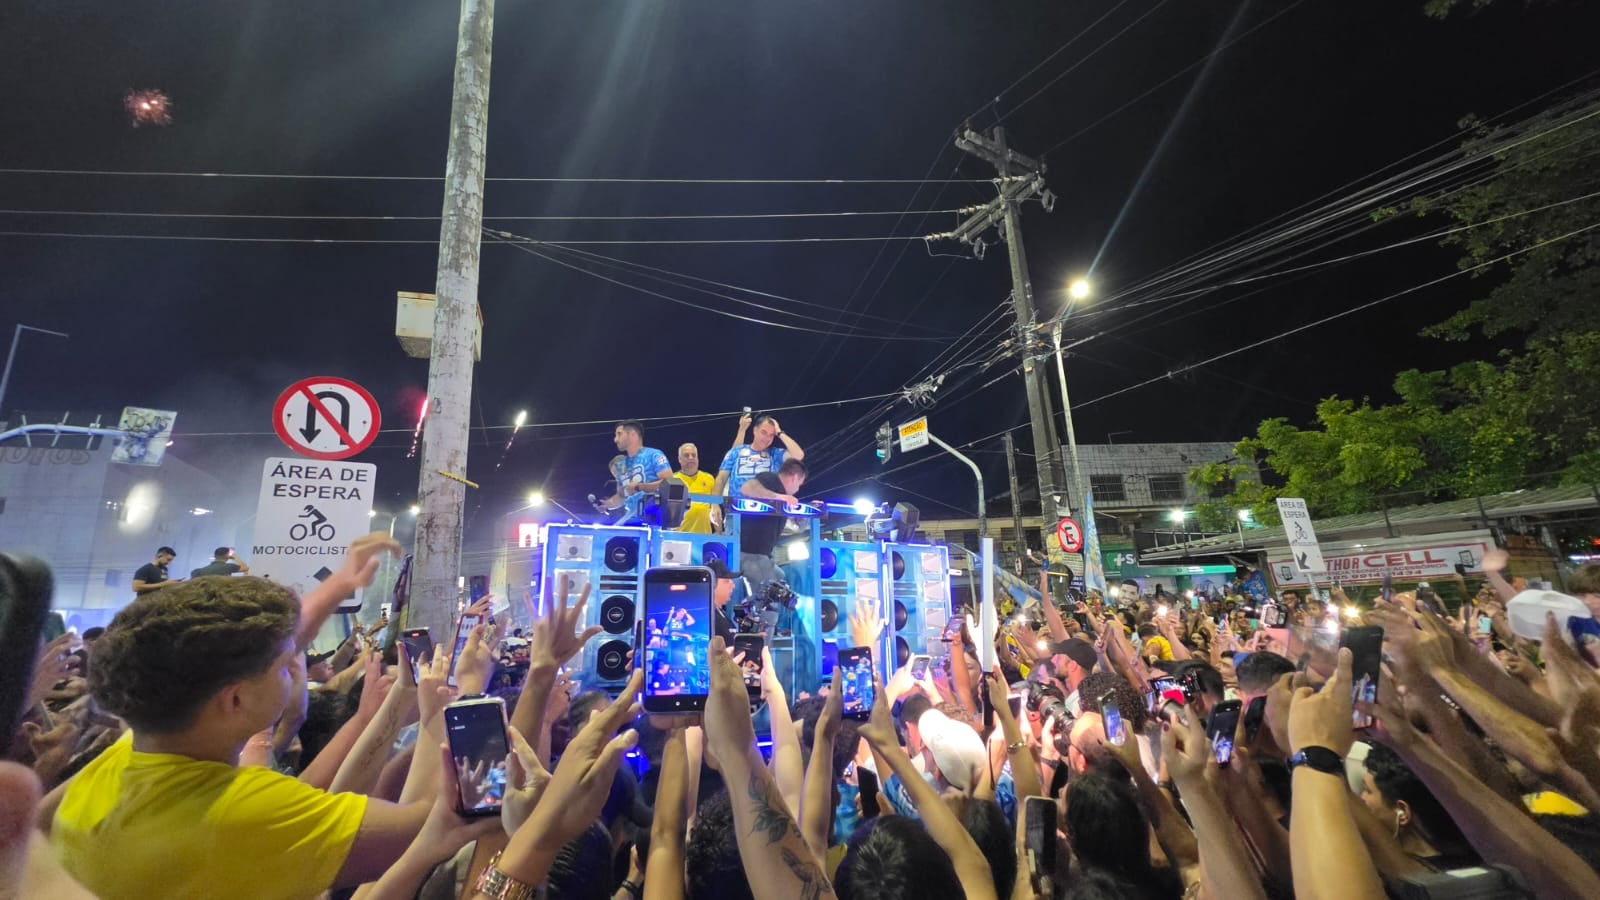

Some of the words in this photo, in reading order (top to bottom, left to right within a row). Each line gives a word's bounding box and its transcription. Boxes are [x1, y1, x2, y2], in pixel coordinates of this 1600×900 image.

[271, 461, 333, 480] ÁREA
[340, 468, 368, 482] DE
[273, 484, 361, 500] ESPERA
[252, 545, 348, 555] MOTOCICLIST
[1363, 550, 1446, 568] CELL
